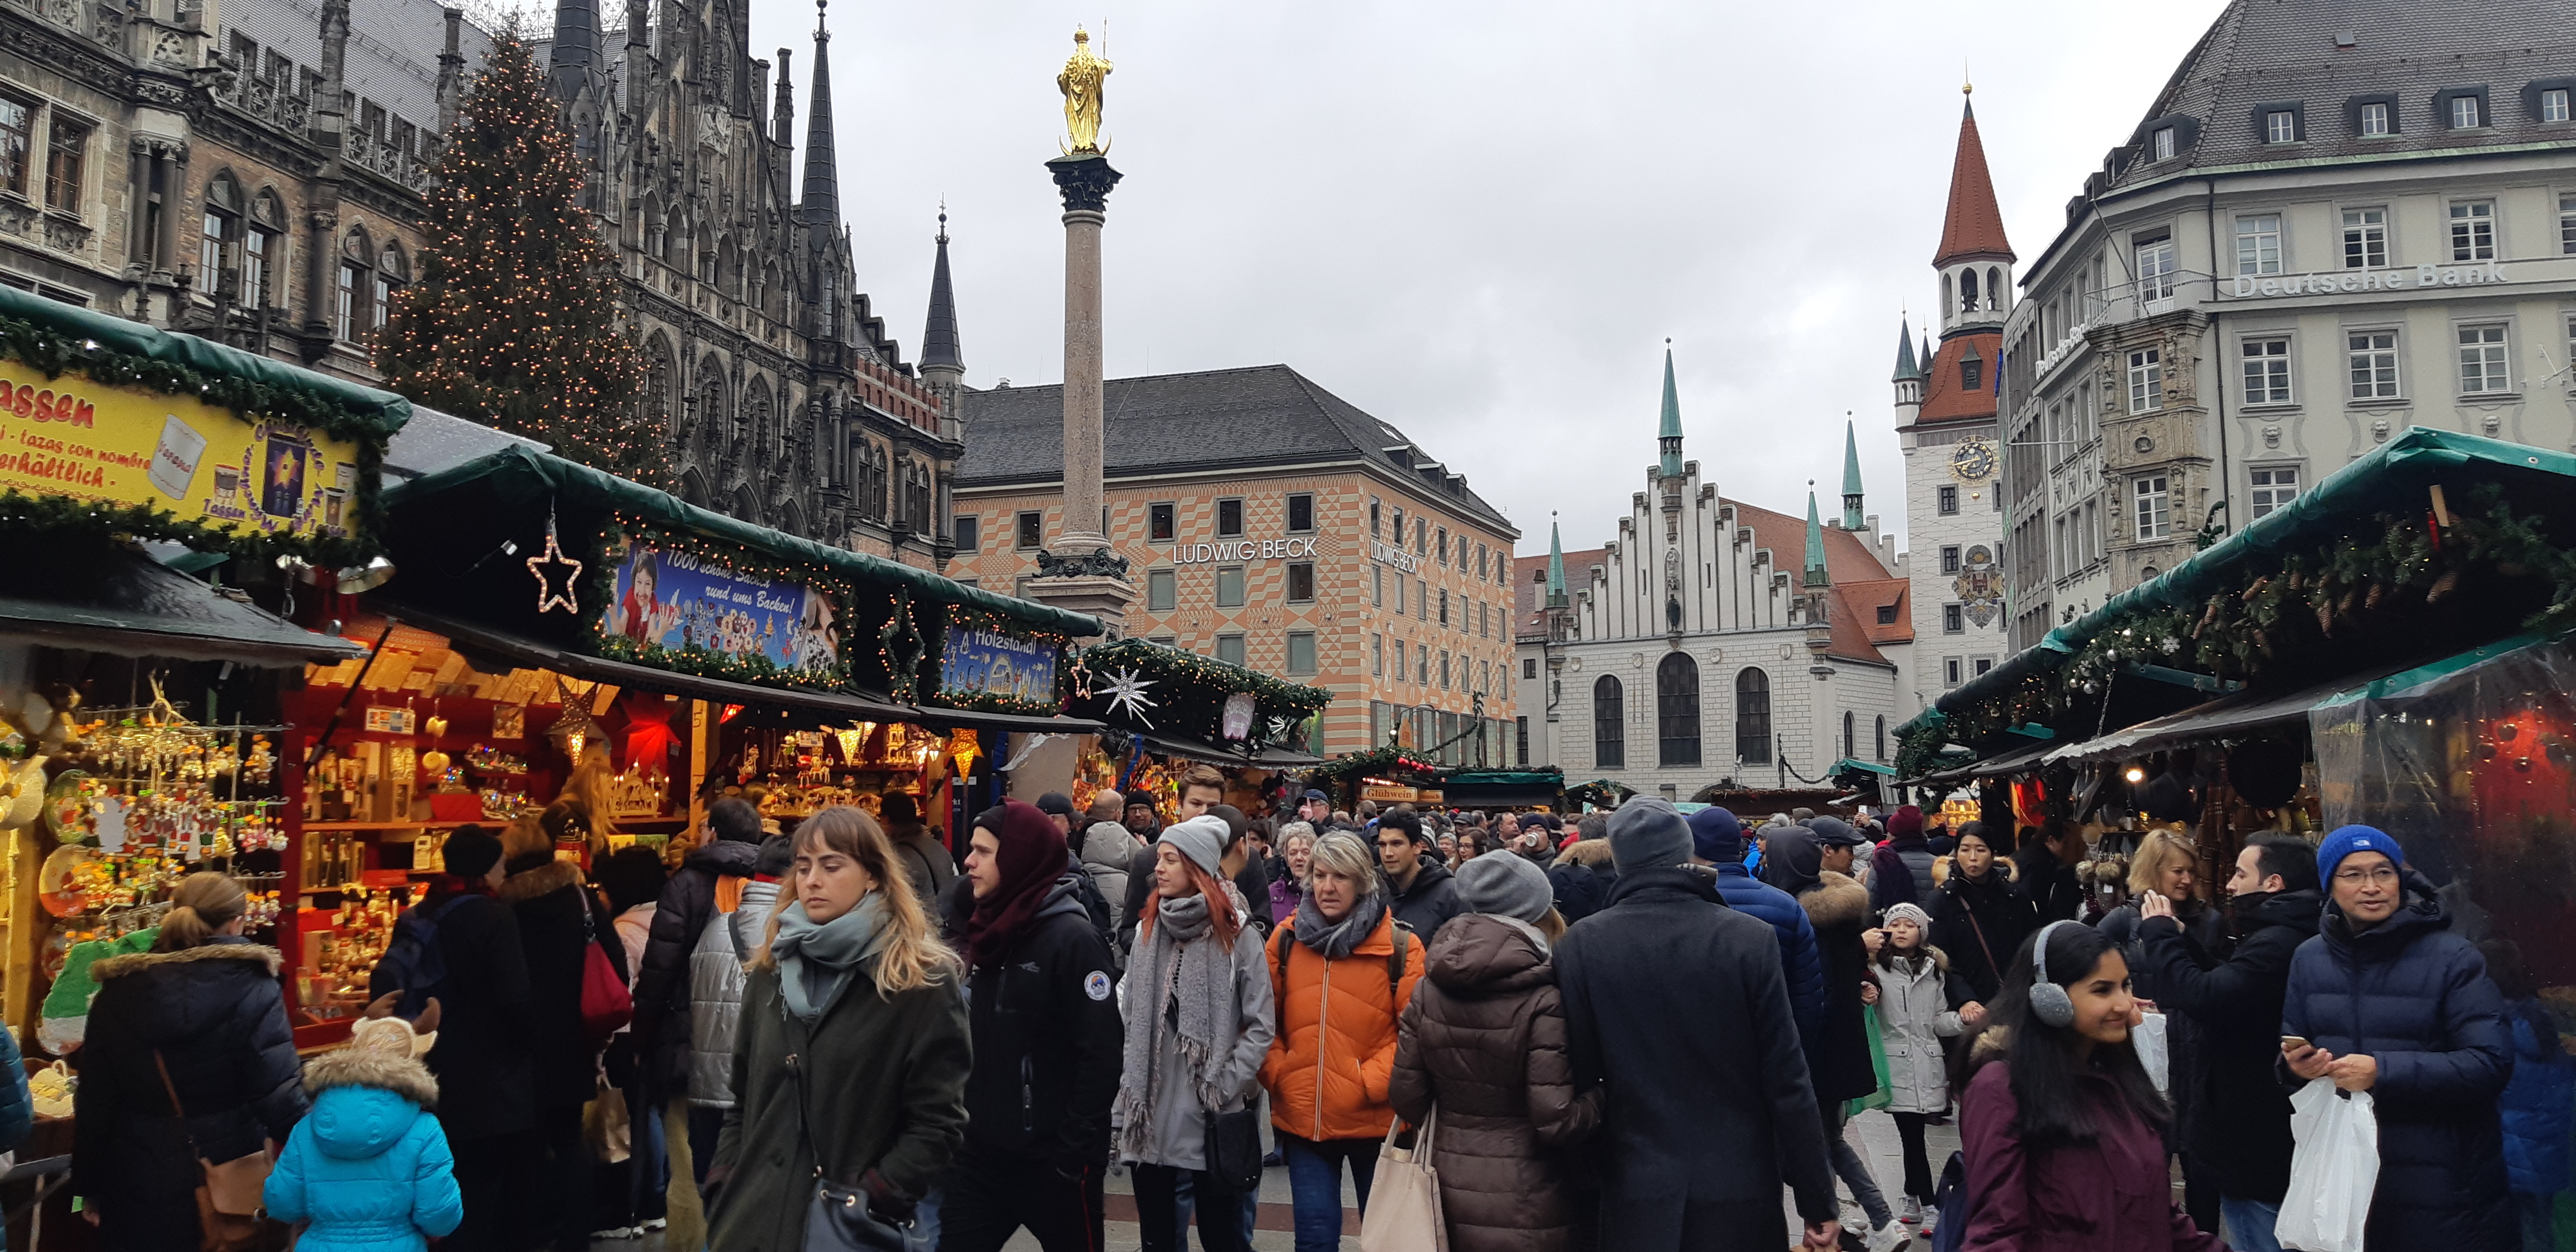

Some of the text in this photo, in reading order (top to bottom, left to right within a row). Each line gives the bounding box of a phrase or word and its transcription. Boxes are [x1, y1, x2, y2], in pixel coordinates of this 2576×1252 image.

[2234, 259, 2508, 297] Deutsche Bank
[19, 428, 64, 454] tazas
[67, 443, 94, 459] con
[97, 451, 152, 470] nombre
[203, 497, 247, 519] Tassen
[667, 549, 699, 571] 1000
[1173, 537, 1318, 564] LUDWIG BECK
[1370, 539, 1417, 574] LUDWIG BECK
[705, 585, 795, 614] rund ums Backen!
[1367, 788, 1412, 799] Glühwein
